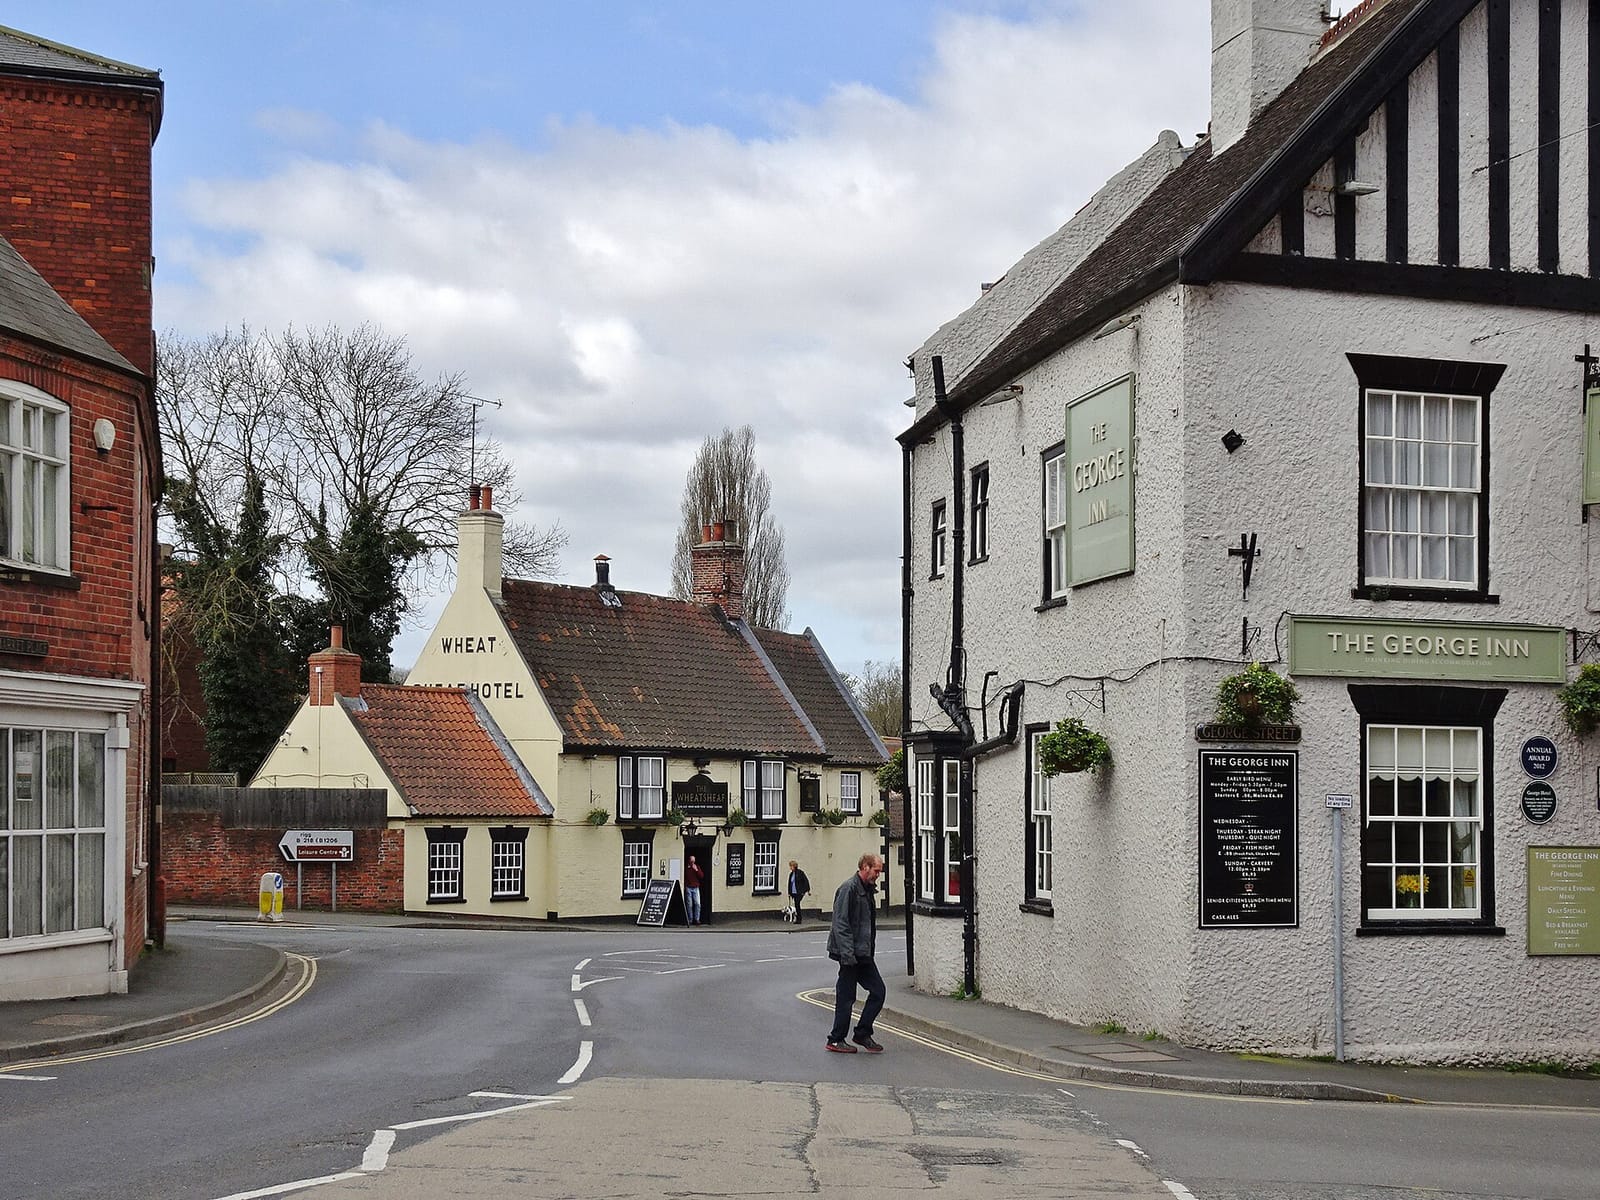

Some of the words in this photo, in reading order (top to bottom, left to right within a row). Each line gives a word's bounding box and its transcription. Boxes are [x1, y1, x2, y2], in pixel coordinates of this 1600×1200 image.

[1090, 422, 1107, 445] THE
[1073, 447, 1125, 494] GEORGE
[1088, 499, 1108, 526] INN
[441, 636, 497, 654] WHEAT
[1327, 632, 1375, 653] THE
[1382, 634, 1479, 656] GEORGE
[1486, 636, 1529, 657] INN
[470, 682, 524, 699] HOTEL
[1202, 725, 1248, 739] GEORGE
[1252, 727, 1297, 740] STREET
[1209, 757, 1227, 766] THE
[1229, 757, 1269, 767] GEORGE
[1271, 758, 1289, 767] INN
[676, 792, 726, 803] WHEATSHEAF
[1535, 852, 1549, 860] THE
[1551, 852, 1582, 860] GEORGE
